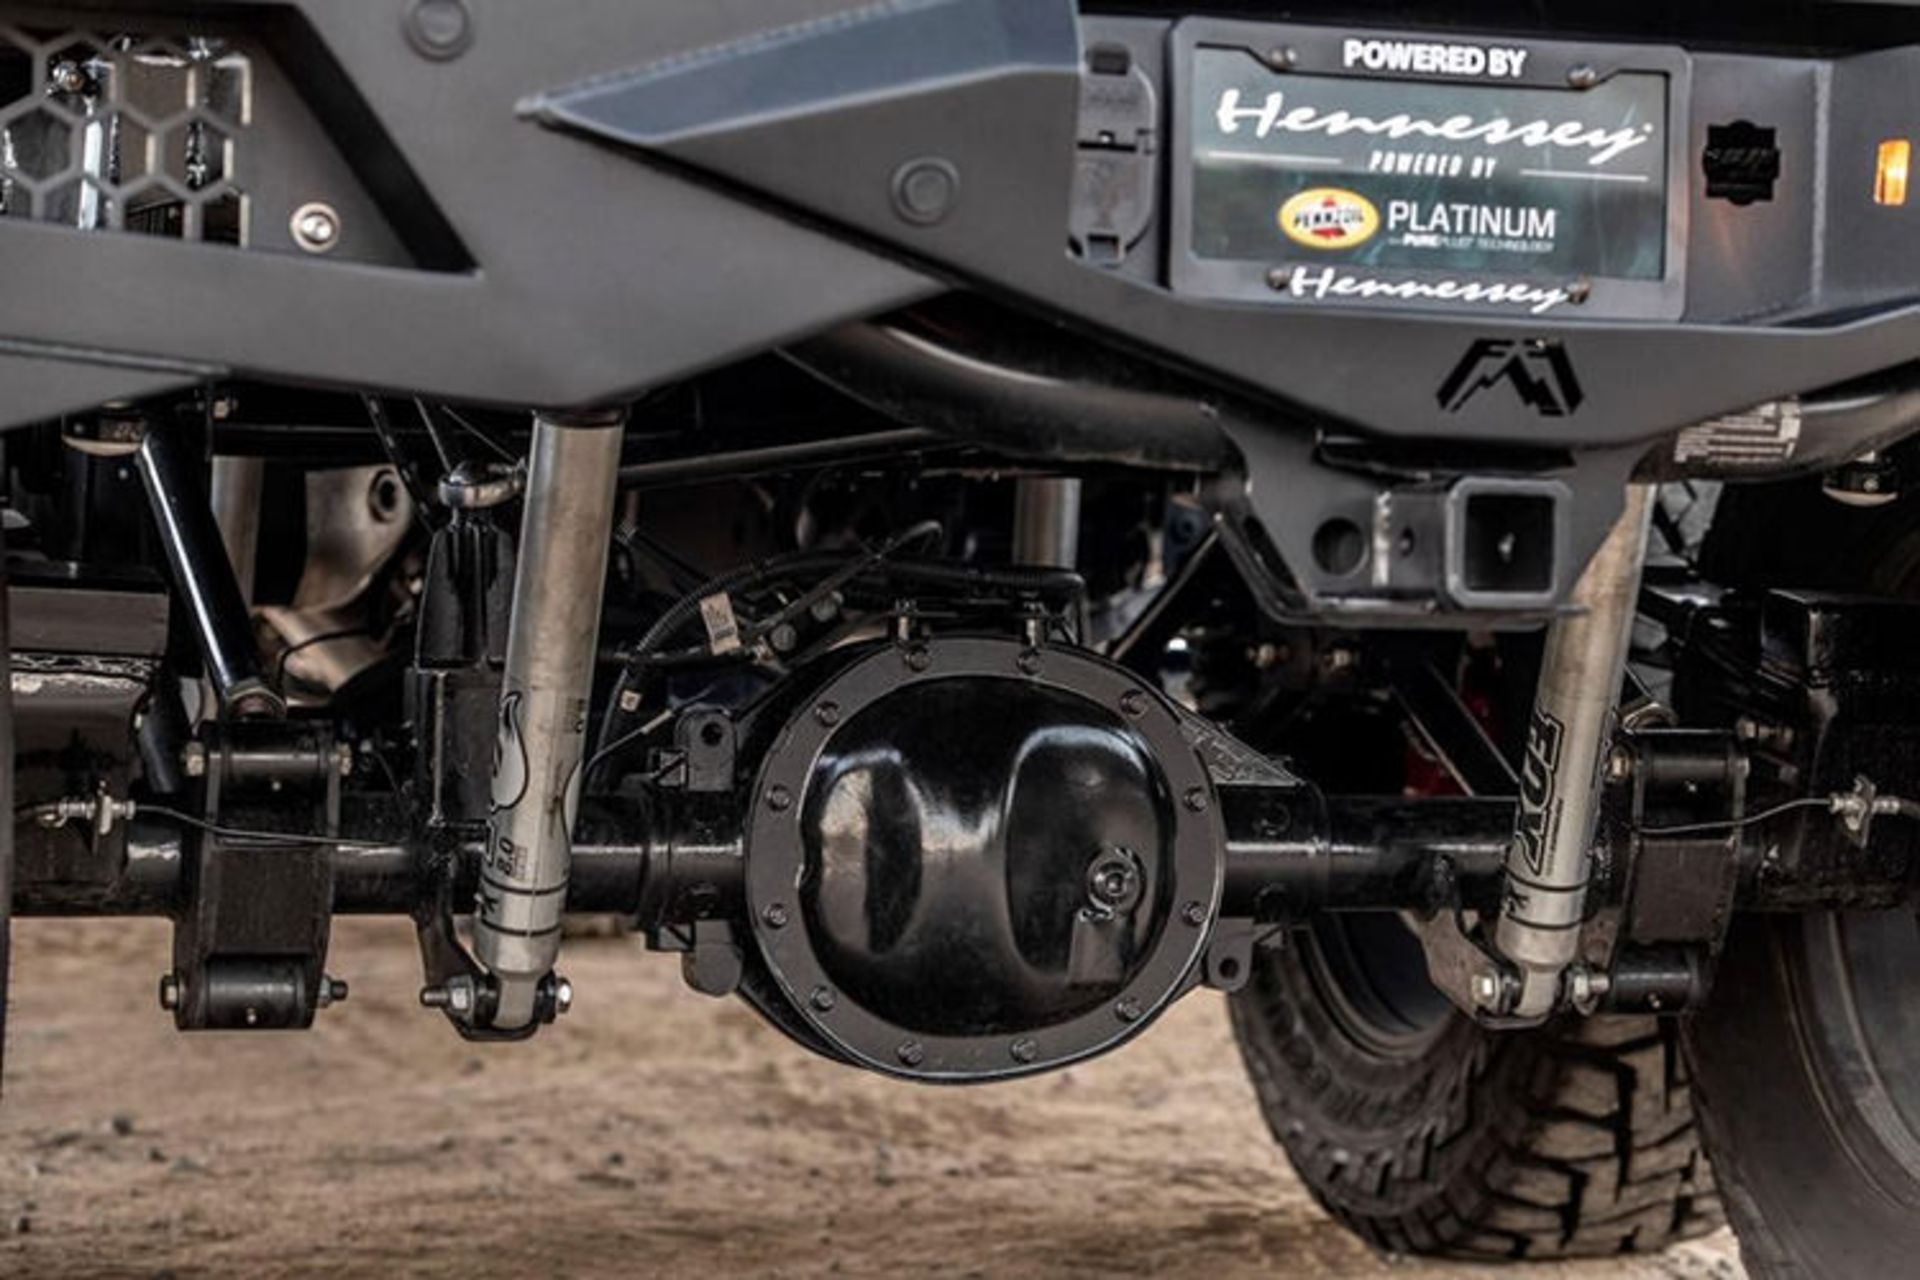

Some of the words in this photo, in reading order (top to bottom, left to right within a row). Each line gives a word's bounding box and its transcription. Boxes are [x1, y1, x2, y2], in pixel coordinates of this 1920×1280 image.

[1343, 39, 1486, 75] POWERED
[1489, 48, 1527, 78] BY
[1216, 88, 1651, 165] Hennessey
[1368, 149, 1463, 178] POWERED
[1470, 155, 1497, 179] BY
[1387, 199, 1556, 239] PLATINUM
[1289, 265, 1569, 315] Hennessey
